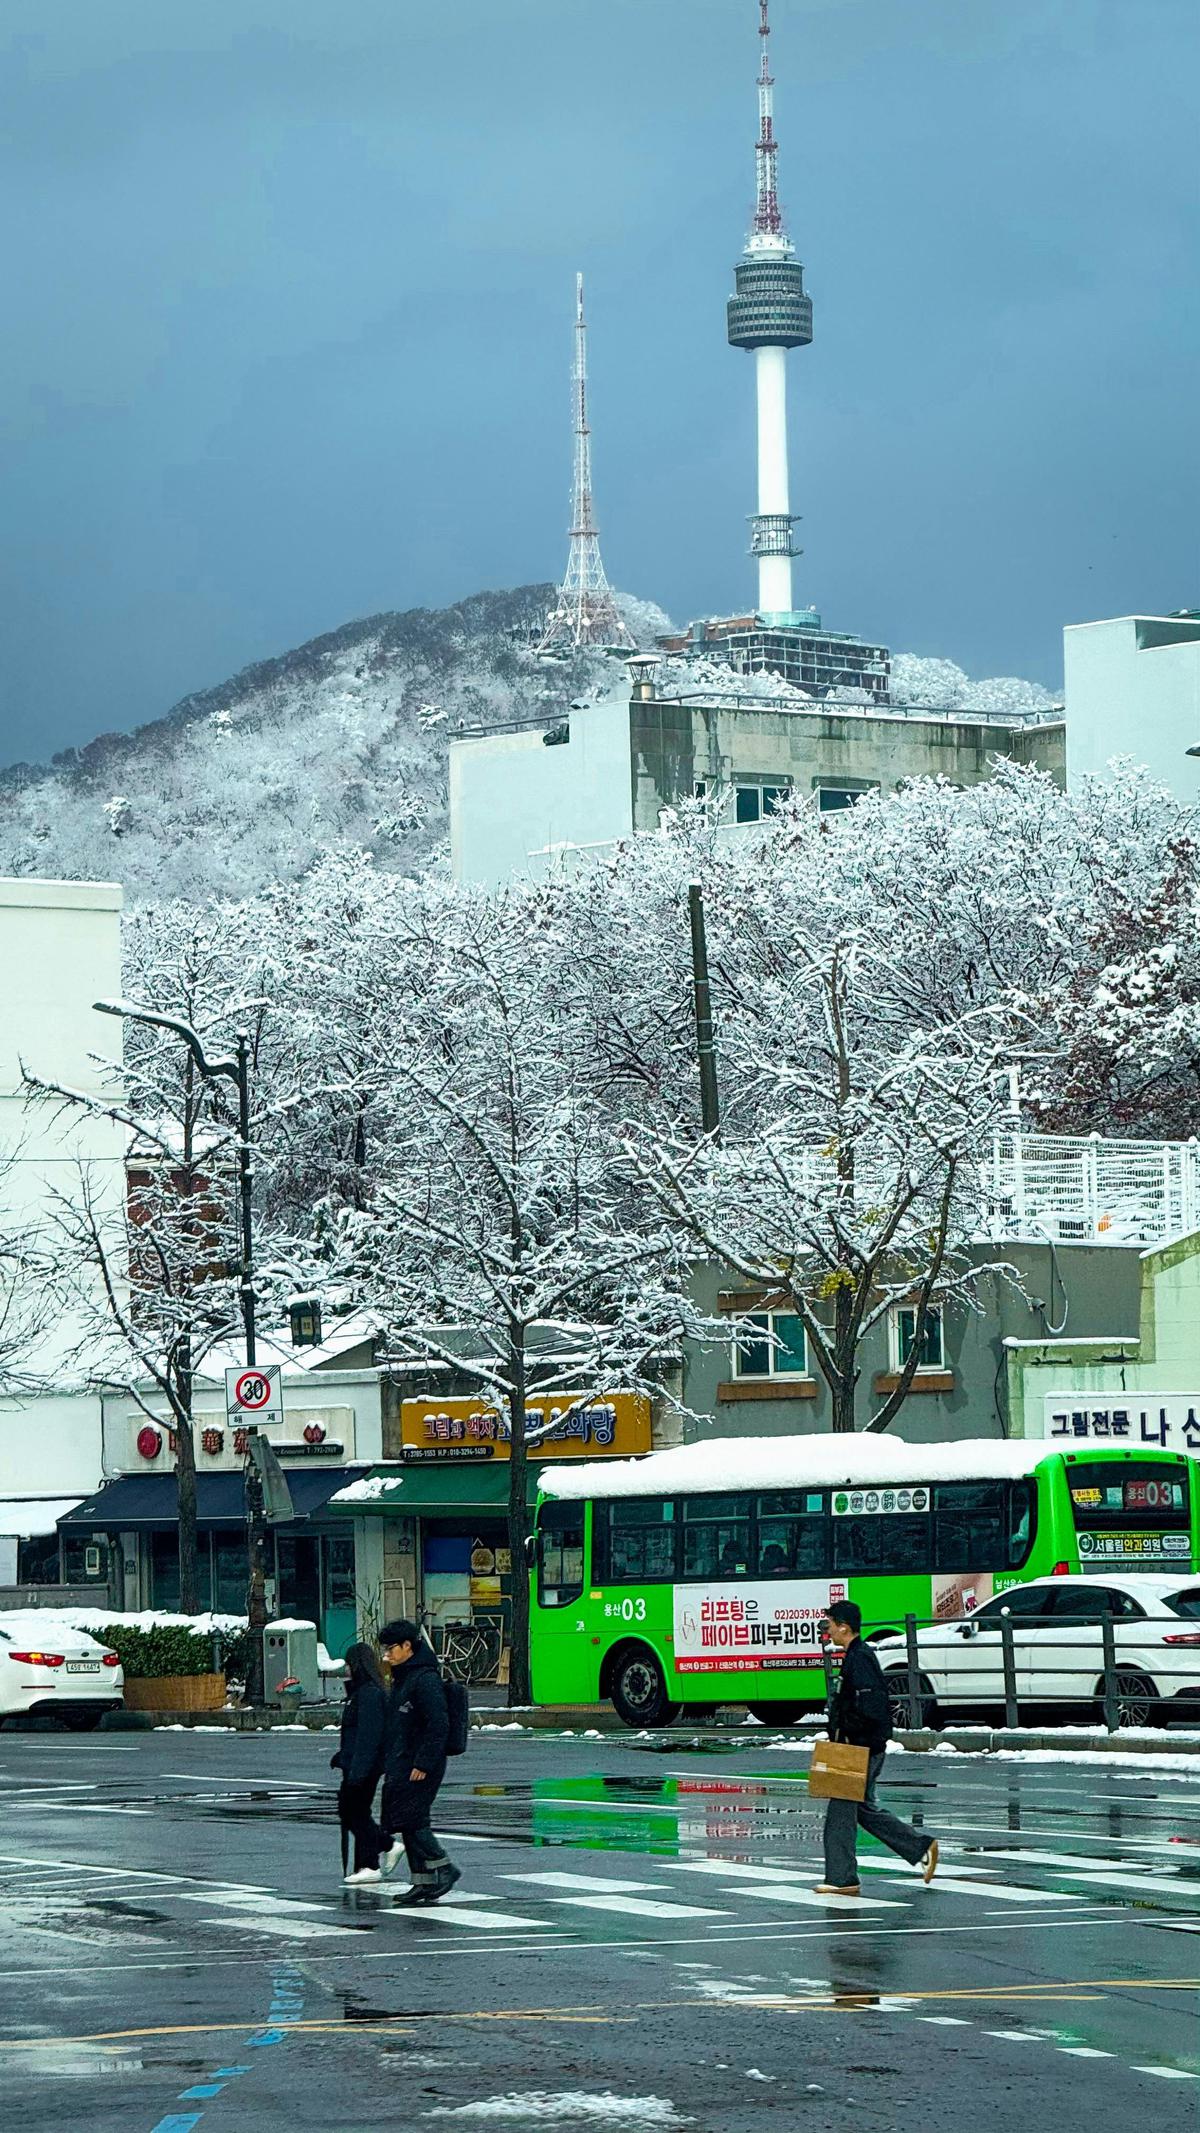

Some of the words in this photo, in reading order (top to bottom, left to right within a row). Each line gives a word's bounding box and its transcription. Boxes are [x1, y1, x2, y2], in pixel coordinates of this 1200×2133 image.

[243, 1379, 264, 1401] 30
[423, 1415, 463, 1440] 그림과
[467, 1416, 495, 1440] 액자
[1051, 1409, 1131, 1436] 그림전문
[1140, 1407, 1172, 1447] 나
[701, 1599, 759, 1622] 리프팅은
[774, 1608, 826, 1620] 02)2039.165
